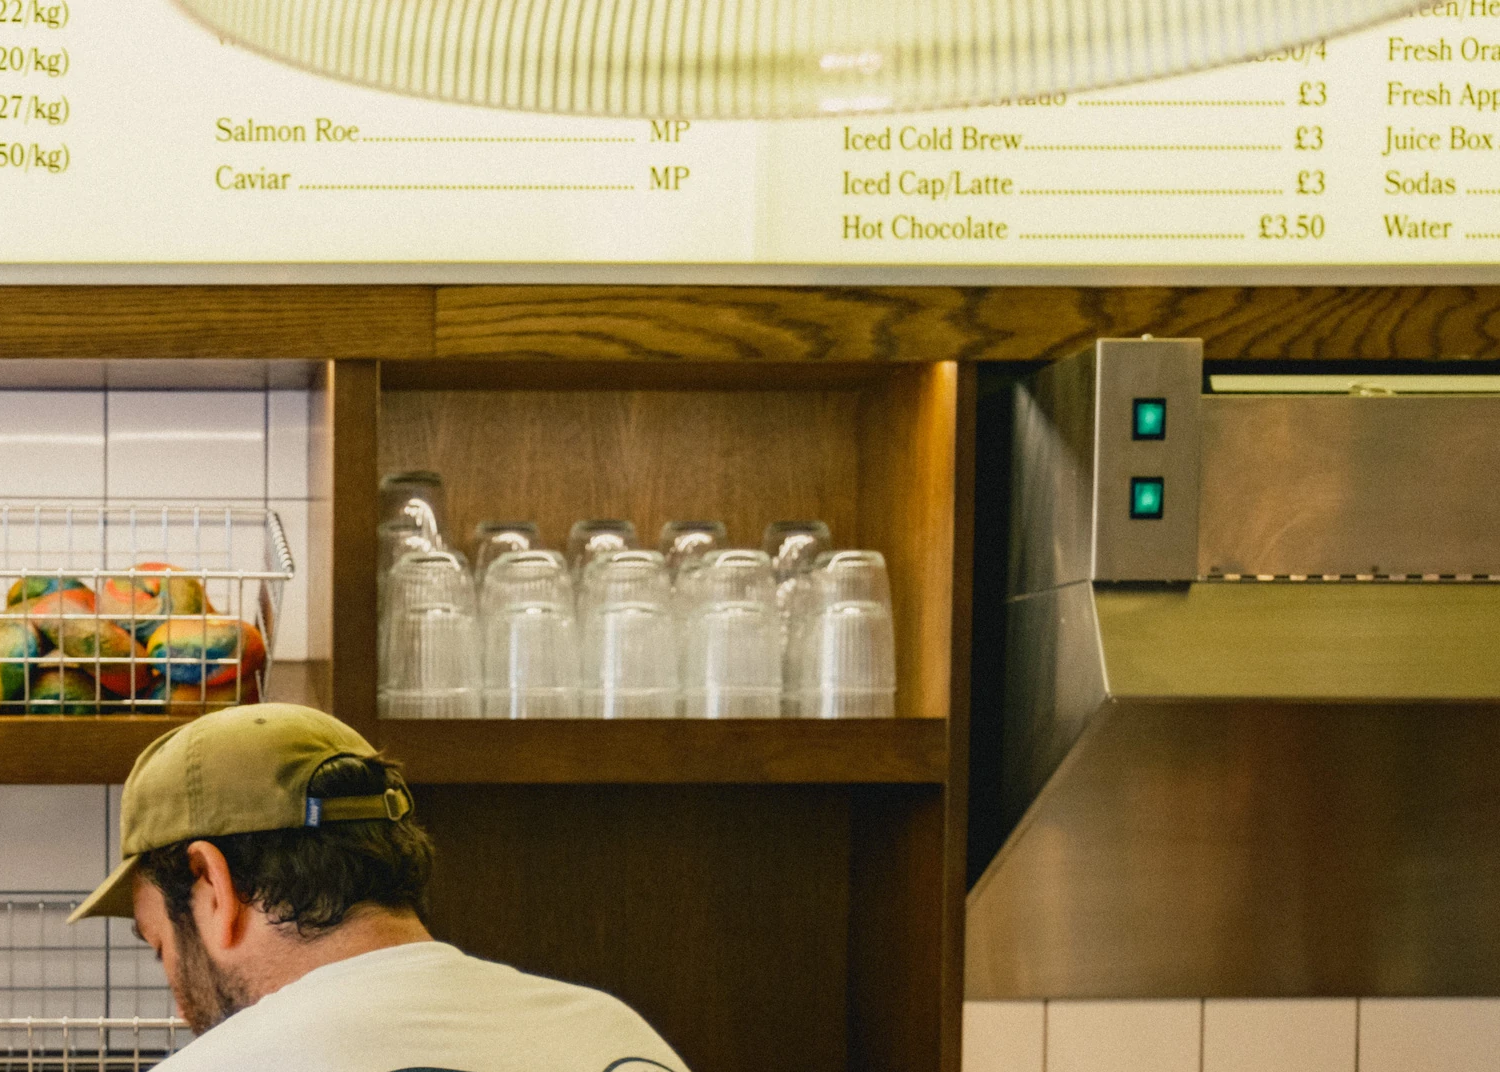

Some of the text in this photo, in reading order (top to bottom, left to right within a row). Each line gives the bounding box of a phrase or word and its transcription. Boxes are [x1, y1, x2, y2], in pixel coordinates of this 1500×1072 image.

[1388, 36, 1452, 62] Fresh
[1297, 81, 1328, 107] £3
[1387, 81, 1451, 106] Fresh
[215, 117, 691, 143] Salmon Roe MP
[844, 125, 1324, 151] Iced Cold Brew £3
[1381, 125, 1493, 157] Juice Box
[215, 165, 691, 191] Caviar MP
[843, 169, 1326, 201] Iced Cap/Latte £3
[1384, 170, 1457, 195] Sodas
[842, 214, 1326, 240] Hot Chocolate £3.50
[1383, 214, 1453, 239] Water
